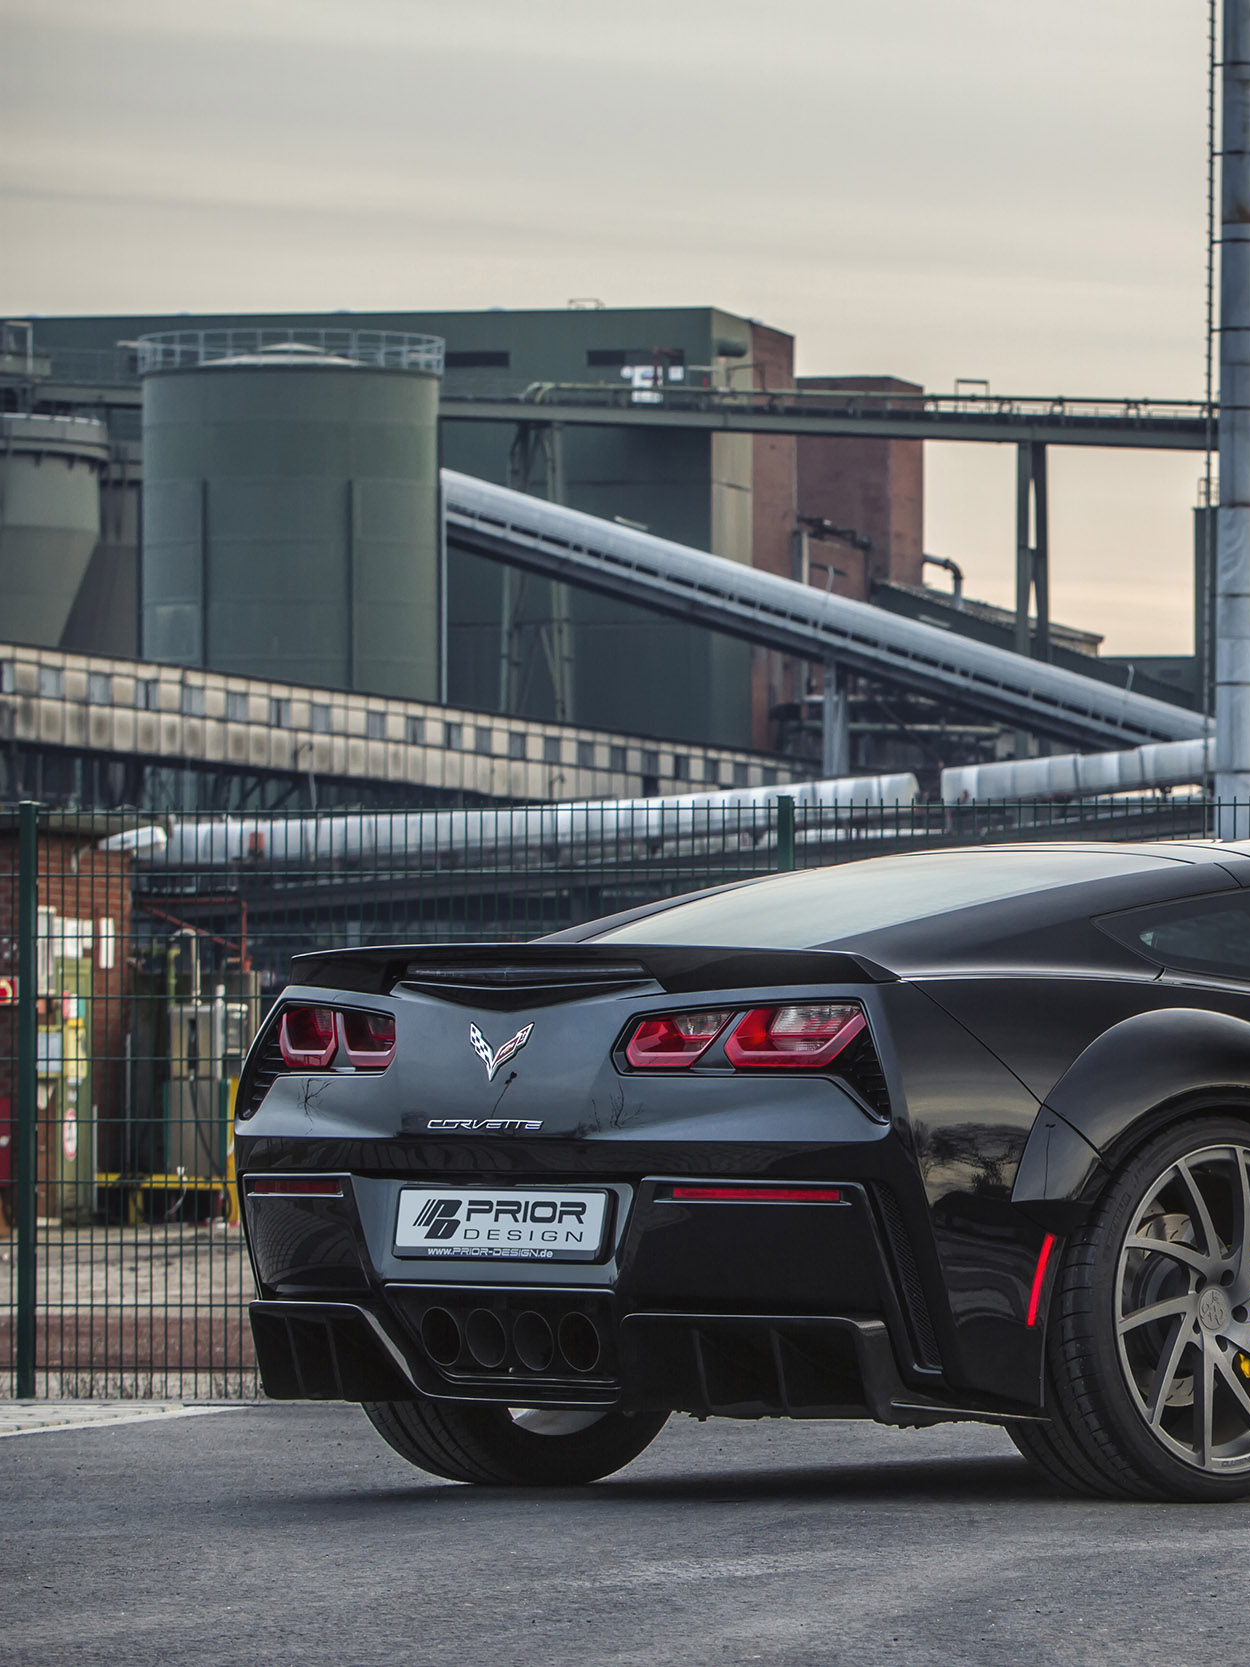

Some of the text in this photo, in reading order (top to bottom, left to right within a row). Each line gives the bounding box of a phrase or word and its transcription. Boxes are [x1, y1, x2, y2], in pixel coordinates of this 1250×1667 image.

[427, 1119, 544, 1130] CORVETTE
[465, 1200, 587, 1225] PRIOR
[463, 1228, 584, 1242] DESIGN
